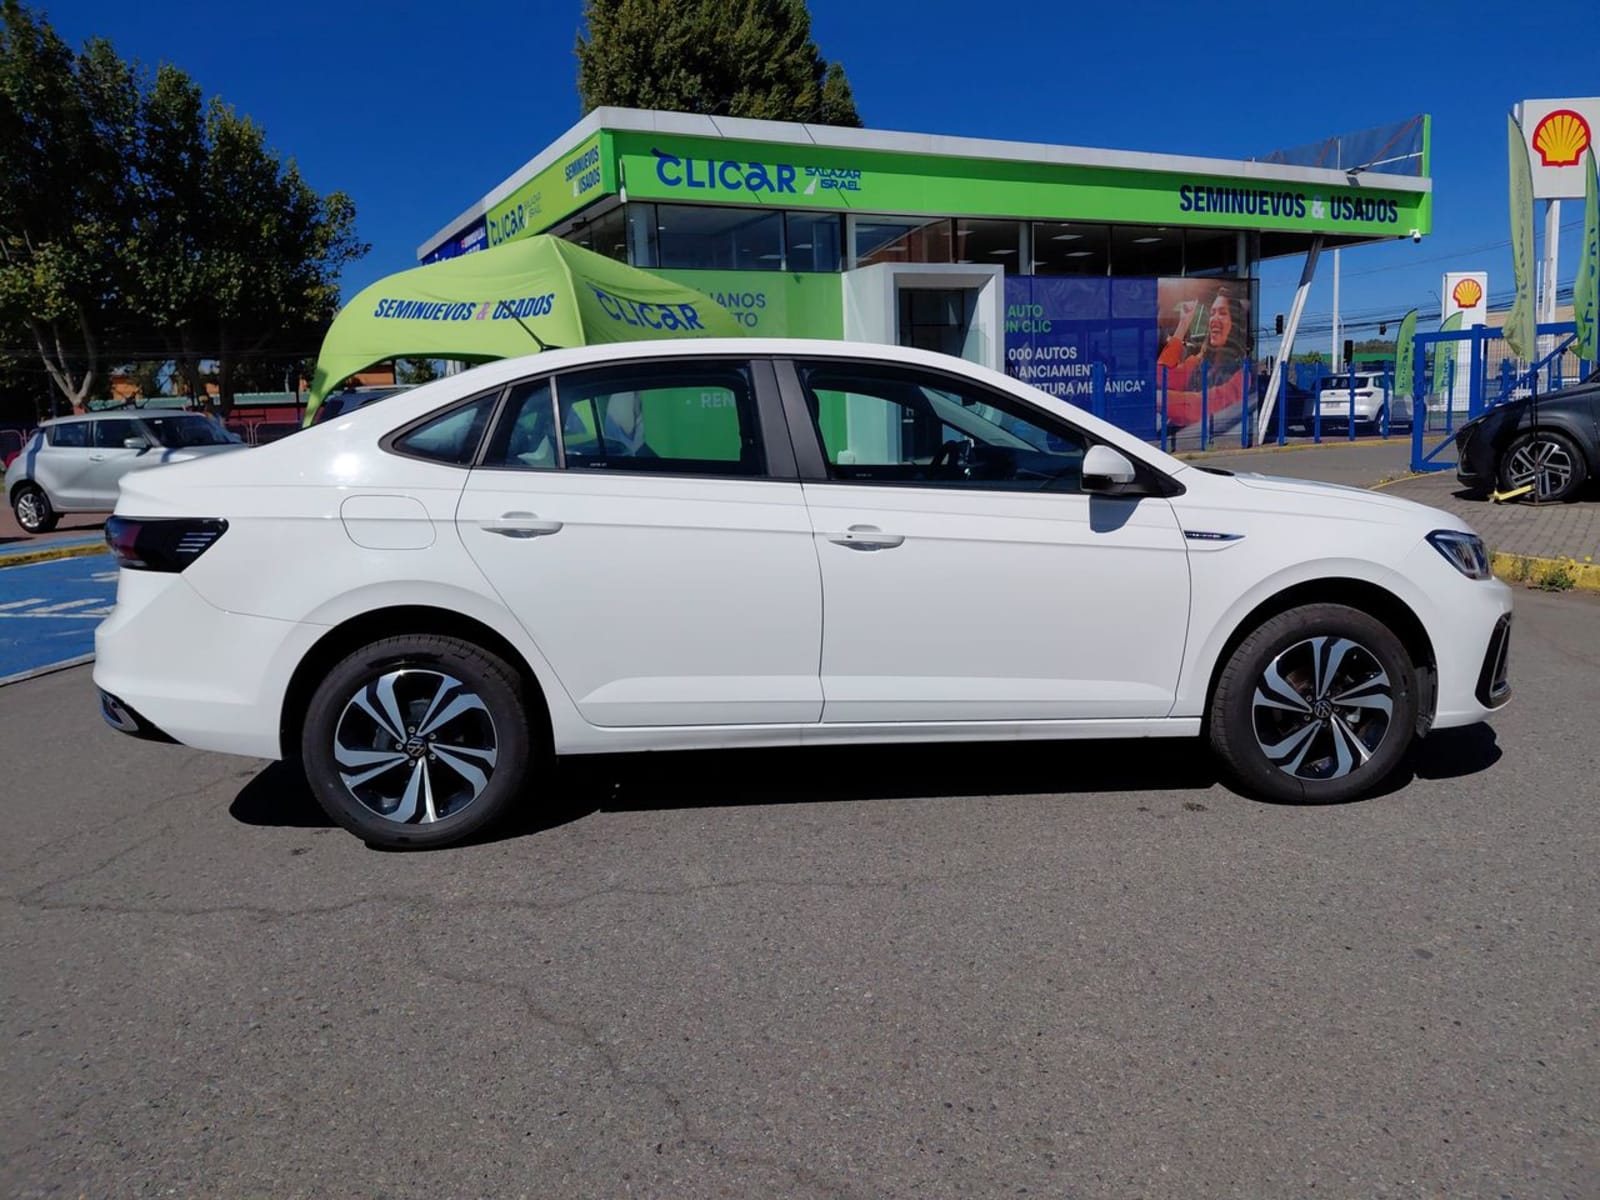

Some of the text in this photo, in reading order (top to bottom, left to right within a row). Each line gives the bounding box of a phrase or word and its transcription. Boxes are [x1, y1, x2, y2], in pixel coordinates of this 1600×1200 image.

[804, 166, 861, 179] SALAZAR
[820, 179, 862, 191] ISRAEL
[1179, 184, 1398, 223] SEMINUEVOS & USADOS
[710, 291, 766, 308] ANOS
[374, 293, 555, 321] SEMINUEVOS & USADOS
[1008, 304, 1044, 318] AUTO
[1022, 320, 1052, 333] CLIC
[1035, 346, 1077, 360] AUTOS
